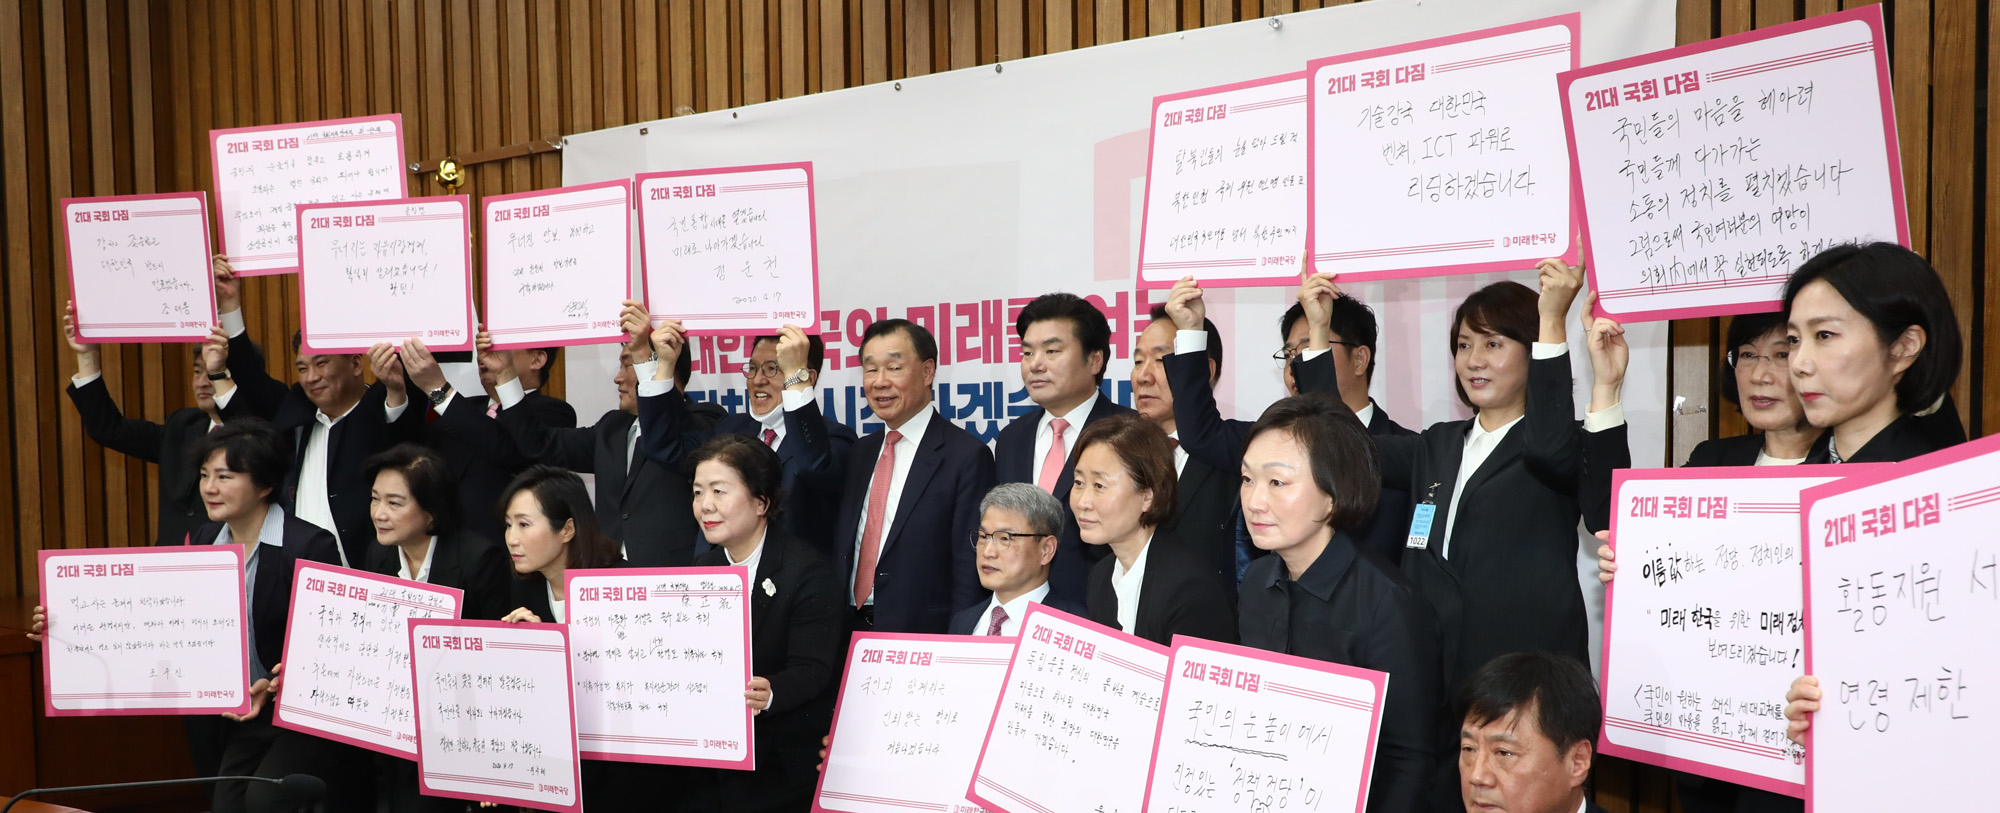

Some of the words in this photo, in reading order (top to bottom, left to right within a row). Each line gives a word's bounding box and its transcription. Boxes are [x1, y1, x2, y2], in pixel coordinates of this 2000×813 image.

[1328, 74, 1356, 95] 21대
[1360, 69, 1390, 90] 국회
[1396, 63, 1426, 84] 다짐
[1584, 88, 1619, 112] 21대
[1623, 80, 1659, 104] 국회
[1664, 70, 1700, 96] 다짐
[1164, 111, 1182, 128] 21대
[1185, 108, 1204, 124] 국회
[1207, 104, 1226, 120] 다짐
[1357, 100, 1414, 130] 기술강국
[1430, 90, 1486, 120] 대한민국
[1612, 107, 1680, 154] 국민들의
[1694, 94, 1746, 131] 마음을
[1758, 80, 1814, 116] 헤아려
[228, 142, 248, 154] 21대
[252, 140, 274, 152] 국회
[278, 138, 299, 150] 다짐
[1422, 133, 1457, 160] ICT
[1468, 126, 1516, 155] 파워로
[1618, 154, 1681, 194] 국민들께
[1694, 136, 1762, 174] 다가가는
[650, 188, 670, 200] 21대
[672, 186, 692, 198] 국회
[696, 184, 716, 197] 다짐
[1630, 193, 1670, 223] 소통의
[1682, 176, 1734, 212] 정치를
[1745, 159, 1854, 206] 펼치겠습니다
[75, 212, 91, 222] 21대
[94, 210, 110, 222] 국회
[112, 210, 129, 220] 다짐
[310, 216, 330, 229] 21대
[333, 216, 352, 228] 국회
[356, 214, 375, 226] 다짐
[494, 209, 510, 222] 21대
[514, 207, 530, 220] 국회
[533, 204, 550, 217] 다짐
[1771, 203, 1811, 235] 여망이
[330, 240, 367, 259] 무너지는
[672, 242, 702, 258] 미래로
[704, 233, 764, 254] 나아가겠습니다
[1512, 233, 1556, 246] 미래한국당
[101, 258, 136, 278] 대한민국
[1268, 256, 1296, 266] 미래한국당
[1714, 253, 1728, 286] 꼭
[1734, 244, 1792, 280] 실현되도록
[346, 265, 368, 283] 확실히
[732, 295, 757, 304] 2020
[772, 291, 782, 303] 17
[1630, 496, 1658, 518] 21대
[1663, 496, 1692, 518] 국회
[1696, 496, 1728, 519] 다짐
[1824, 514, 1856, 548] 21대
[1861, 503, 1897, 538] 국회
[1903, 492, 1940, 530] 다짐
[1410, 537, 1426, 546] 1022
[1749, 542, 1794, 569] 정치인의
[56, 565, 79, 578] 21대
[84, 564, 107, 577] 국회
[111, 564, 134, 576] 다짐
[306, 578, 324, 592] 21대
[328, 582, 346, 597] 국회
[349, 586, 368, 602] 다짐
[580, 588, 600, 602] 21대
[602, 587, 623, 602] 국회
[626, 587, 647, 601] 다짐
[1838, 562, 1946, 633] 활동지원
[696, 612, 710, 632] 국회
[1730, 609, 1750, 630] 위한
[422, 635, 440, 649] 21대
[443, 636, 462, 650] 국회
[464, 637, 484, 651] 다짐
[1032, 624, 1053, 645] 21대
[1053, 632, 1074, 652] 국회
[1075, 639, 1096, 660] 다짐
[862, 649, 884, 663] 21대
[886, 650, 908, 664] 국회
[910, 651, 932, 666] 다짐
[861, 676, 892, 696] 국민과
[908, 680, 946, 696] 함께하는
[1027, 650, 1064, 676] 독립운동
[1070, 664, 1090, 684] 정신의
[1132, 690, 1160, 712] 계승으로
[1182, 660, 1206, 682] 21대
[1208, 665, 1233, 688] 국회
[1235, 670, 1260, 692] 다짐
[1677, 688, 1702, 712] 원하는
[1738, 700, 1784, 720] 세대교체를
[1840, 681, 1889, 732] 연령
[1905, 667, 1970, 720] 제한
[883, 710, 920, 727] 신뢰받는
[936, 709, 958, 725] 정치로
[1083, 702, 1110, 720] 대한민국
[1008, 720, 1026, 738] 만들어
[1014, 702, 1034, 719] 미래를
[1090, 730, 1120, 750] 대한민국을
[1738, 720, 1758, 743] 함께
[710, 739, 738, 750] 미래한국당
[887, 741, 940, 756] 거듭나겠습니다
[544, 784, 568, 796] 미래한국당
